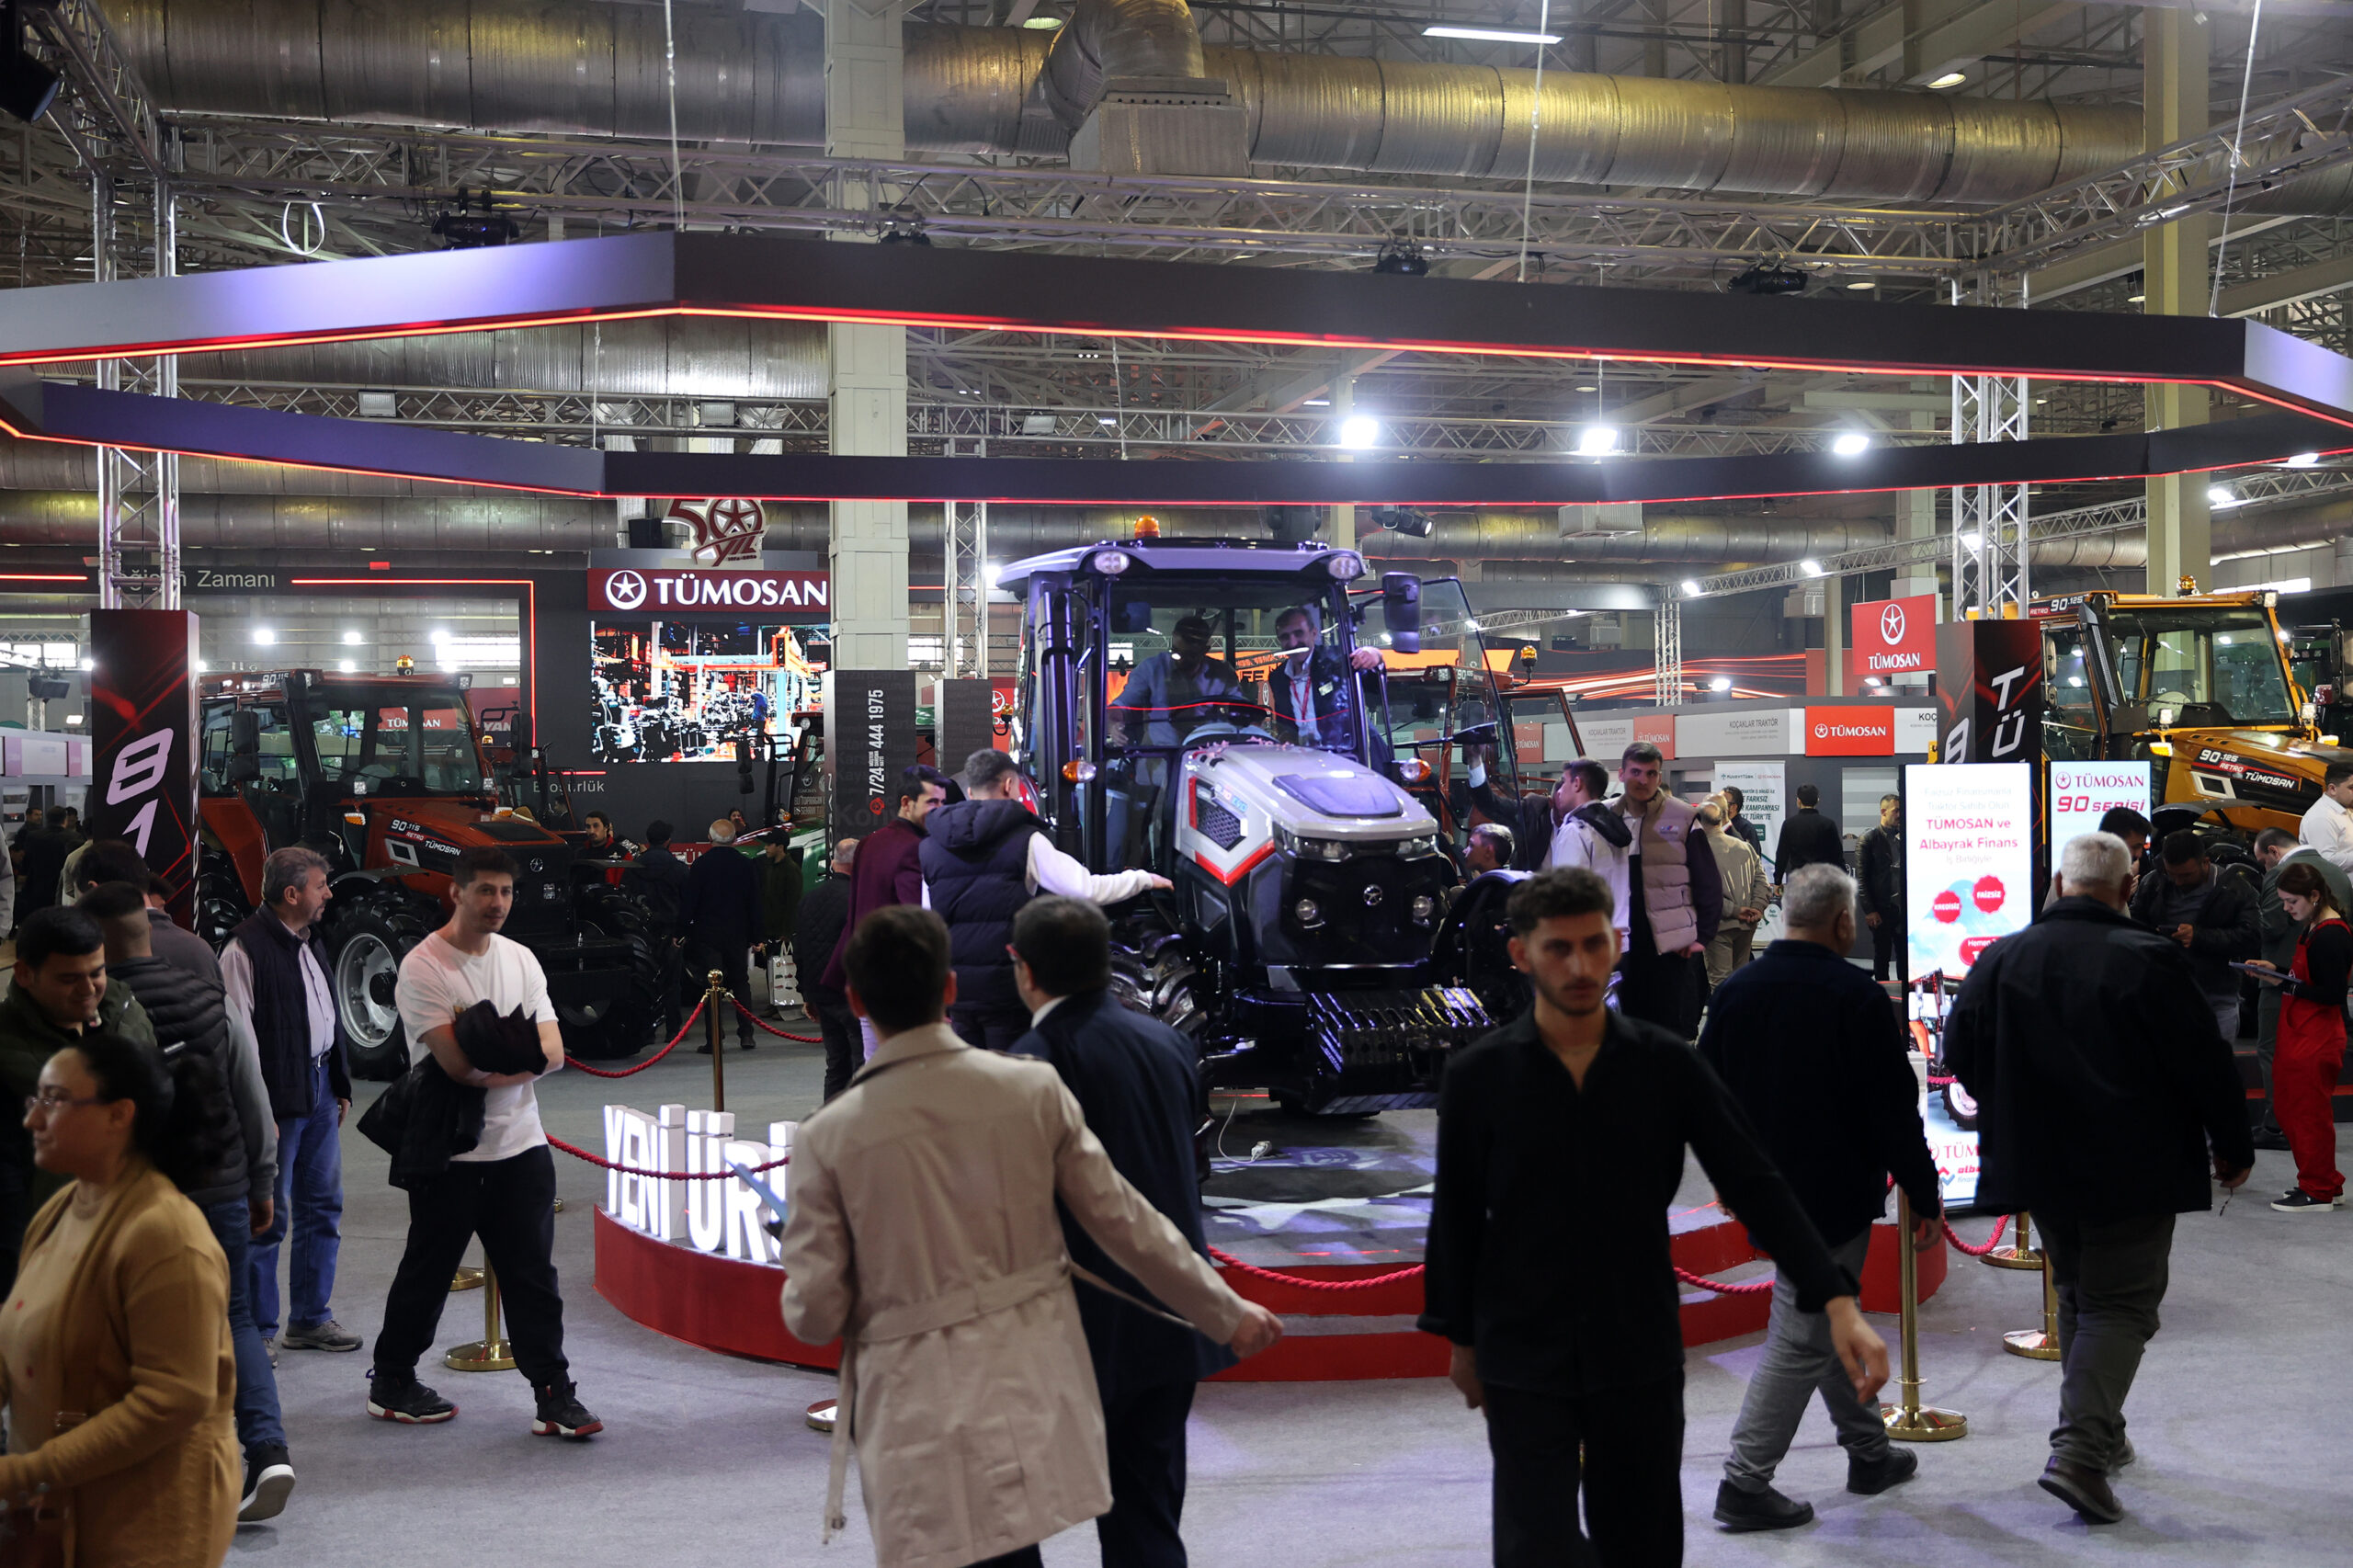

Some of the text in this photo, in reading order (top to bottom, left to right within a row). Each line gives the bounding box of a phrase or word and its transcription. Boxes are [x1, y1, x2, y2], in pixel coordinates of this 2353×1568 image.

[197, 570, 275, 587] Zamanı
[654, 574, 827, 606] TÜMOSAN
[1868, 652, 1921, 671] TÜMOSAN
[869, 689, 885, 749] 444 1975
[1830, 724, 1886, 737] TÜMOSAN
[2219, 762, 2244, 772] RETRO
[869, 767, 885, 796] 7/24
[2075, 773, 2144, 788] TÜMOSAN
[2245, 771, 2295, 789] TÜMOSAN
[2057, 796, 2089, 812] 90
[1927, 816, 2011, 830] TÜMOSAN ve
[405, 831, 425, 841] RETRO
[1919, 836, 2018, 852] Albayrak Finans
[425, 840, 461, 856] TÜMOSAN
[603, 1104, 678, 1242] YENİ
